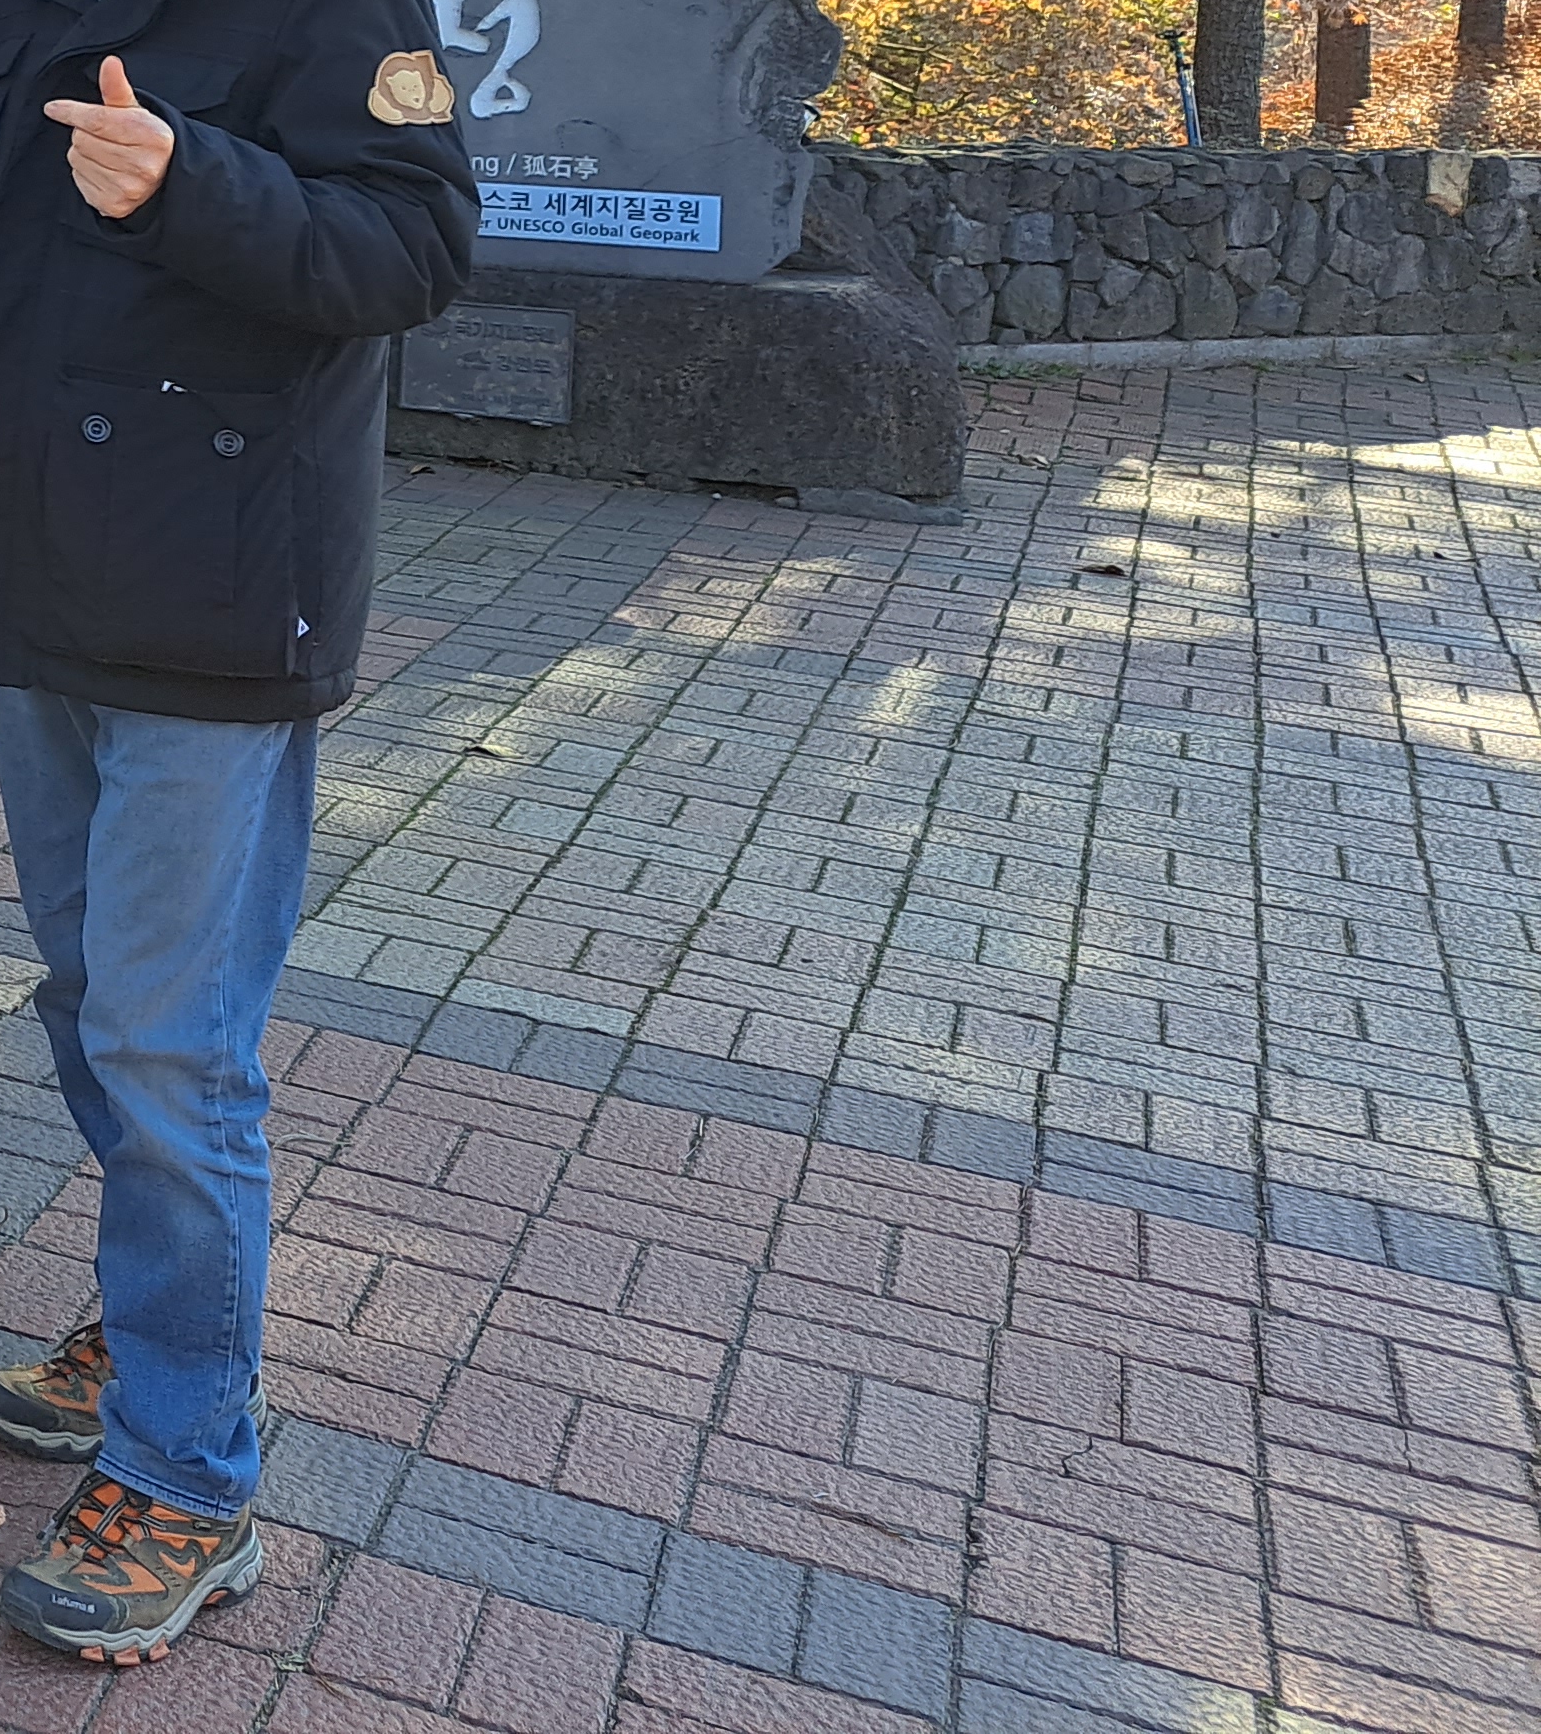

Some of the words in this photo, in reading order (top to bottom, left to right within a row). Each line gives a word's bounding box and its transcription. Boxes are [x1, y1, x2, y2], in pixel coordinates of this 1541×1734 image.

[543, 191, 701, 225] 세계지질공원
[497, 217, 565, 235] UNESCO
[571, 222, 624, 239] Global
[630, 225, 701, 245] Geopark
